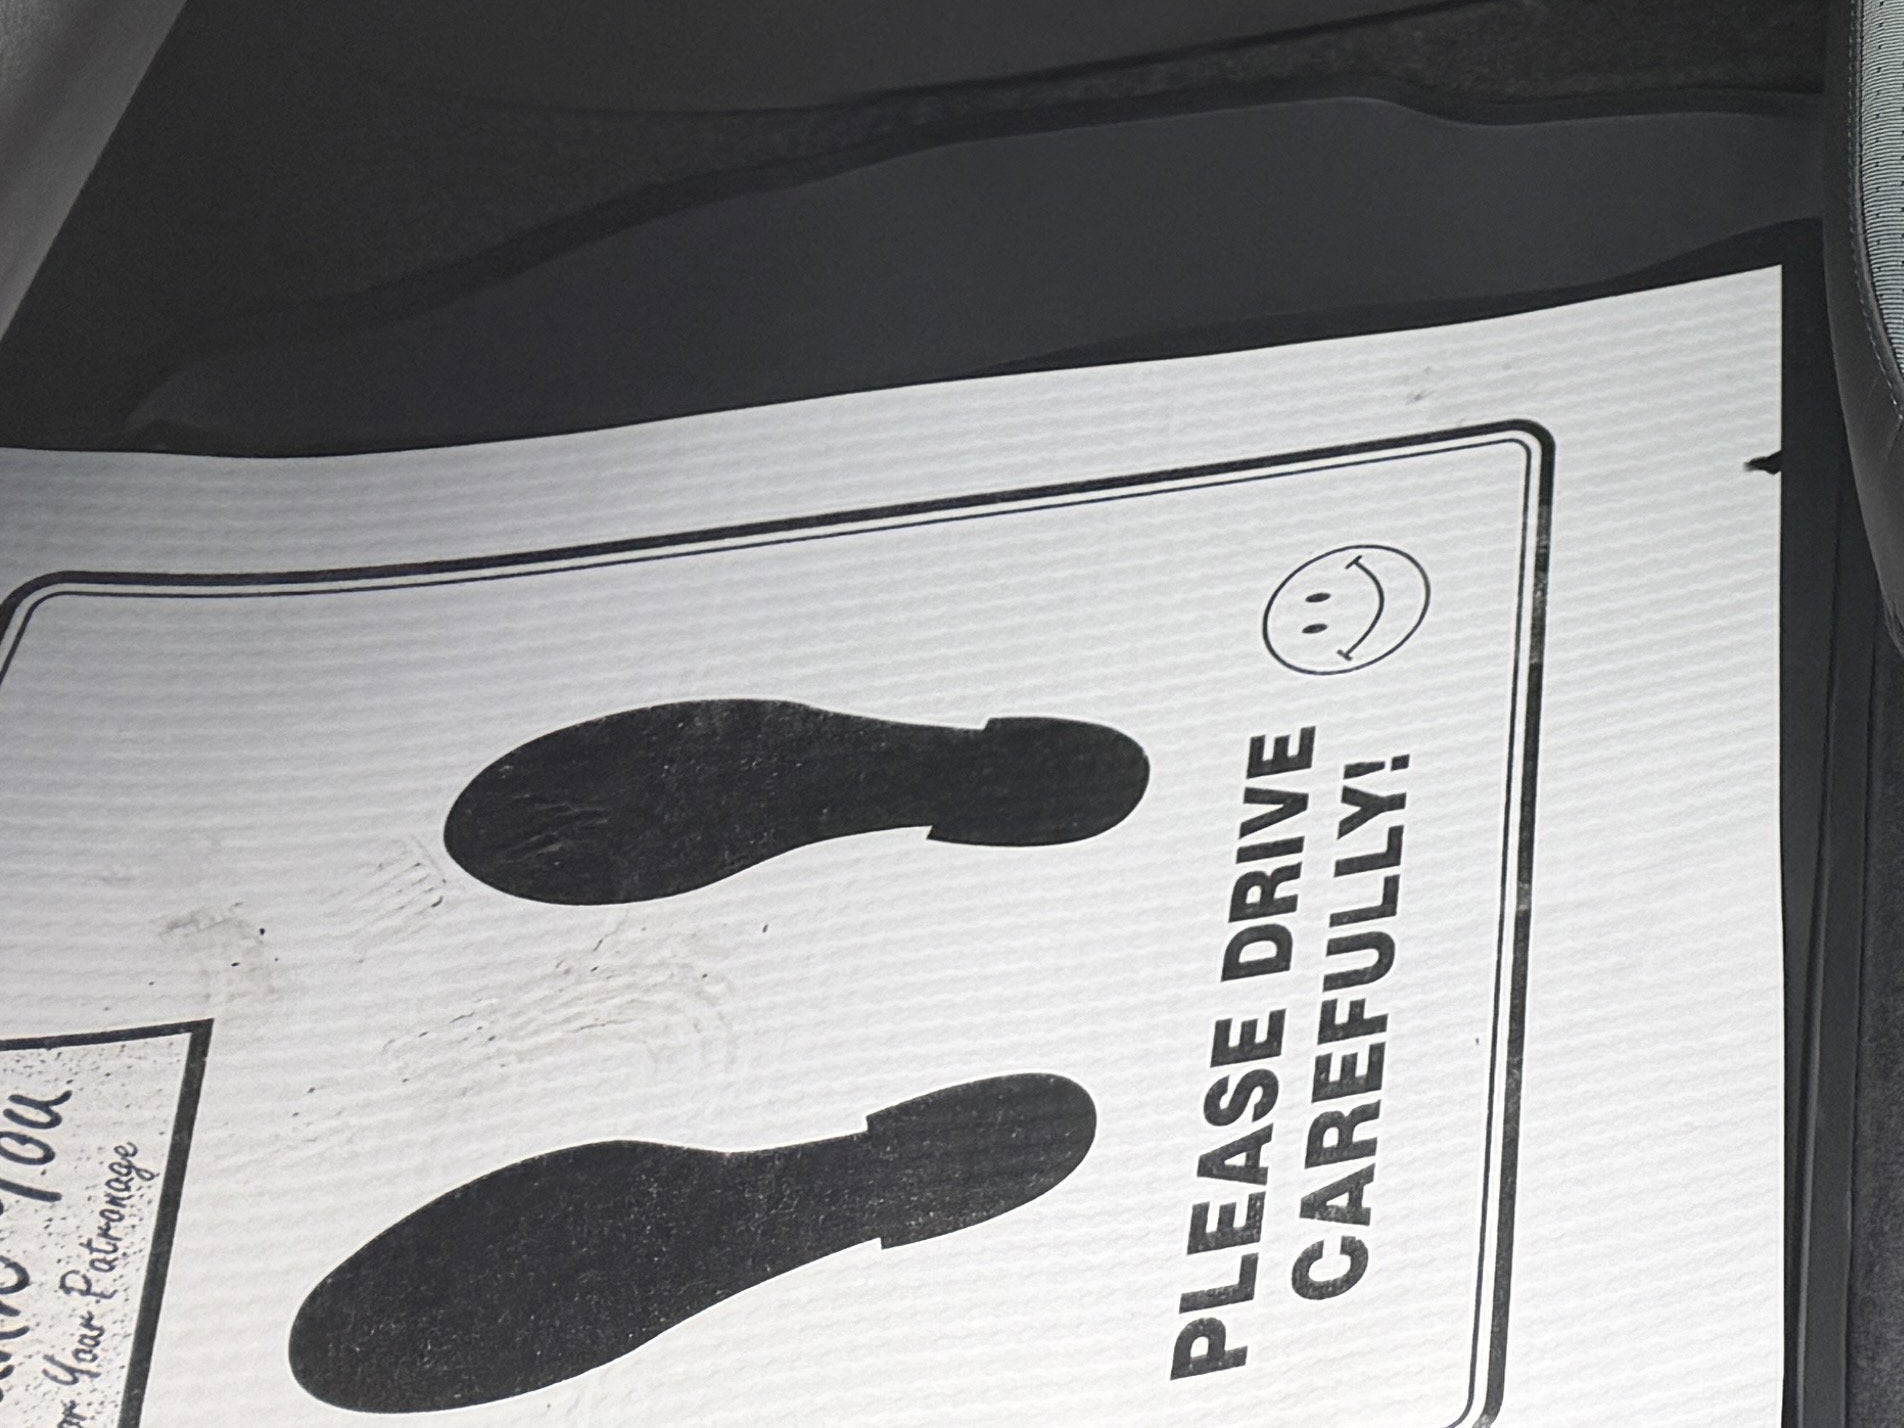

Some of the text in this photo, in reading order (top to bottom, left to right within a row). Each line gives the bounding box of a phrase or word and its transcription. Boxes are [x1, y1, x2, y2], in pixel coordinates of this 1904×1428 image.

[59, 1141, 160, 1299] Patronage
[1170, 724, 1316, 1381] PLEASE DRIVE
[1291, 753, 1411, 1301] CAREFULLY!
